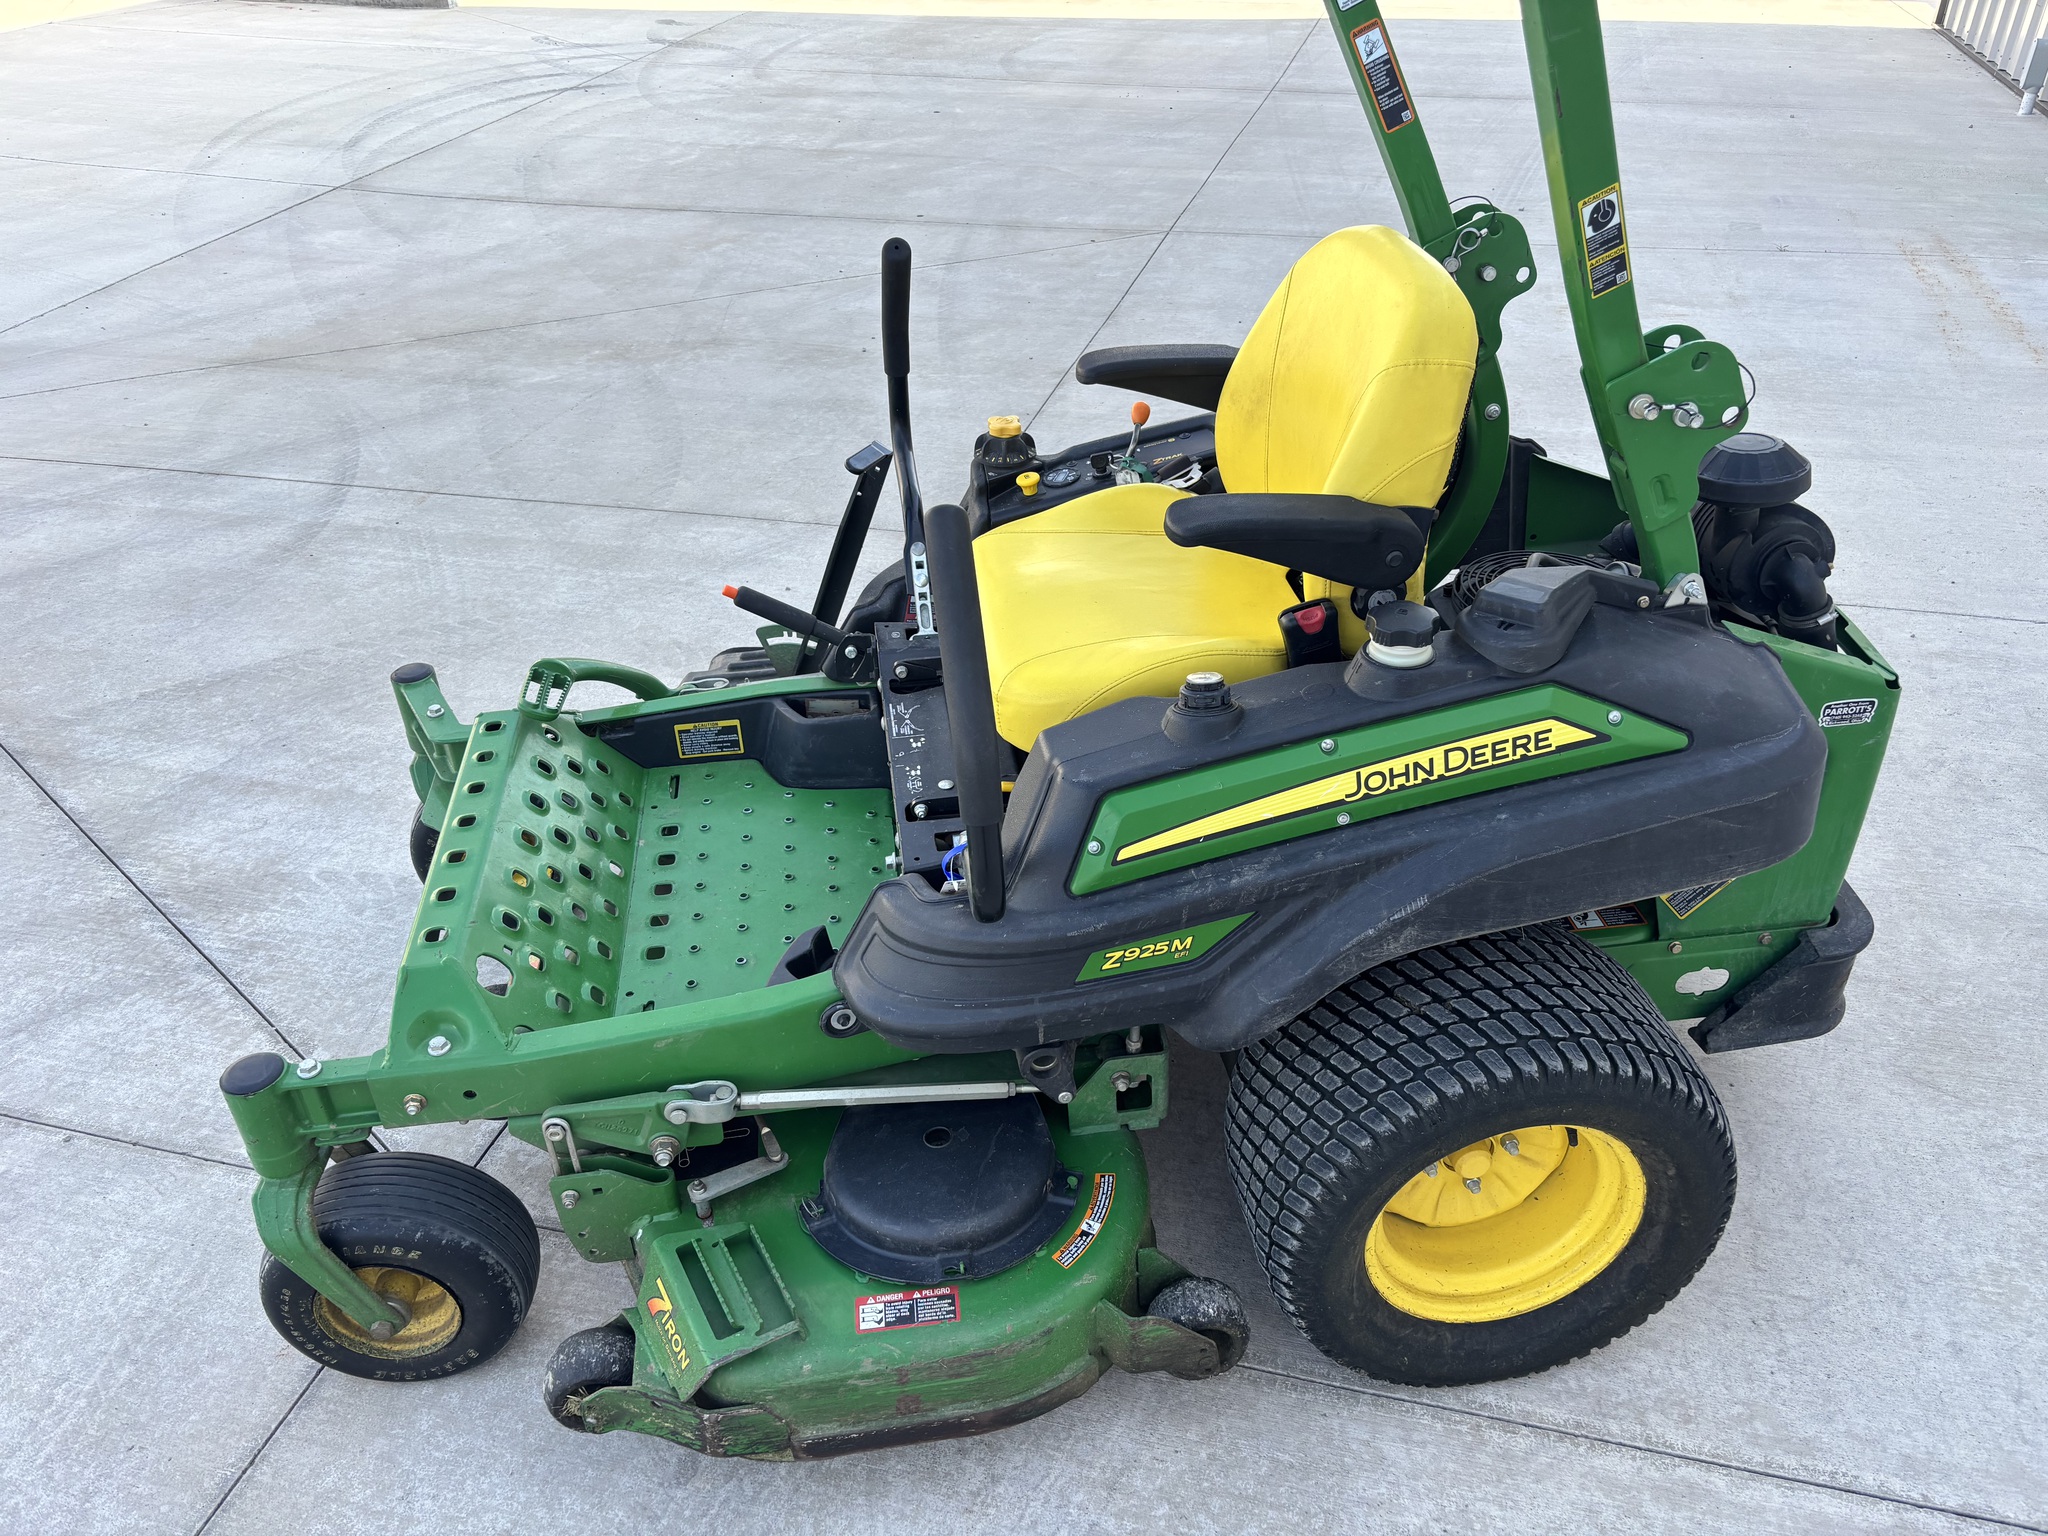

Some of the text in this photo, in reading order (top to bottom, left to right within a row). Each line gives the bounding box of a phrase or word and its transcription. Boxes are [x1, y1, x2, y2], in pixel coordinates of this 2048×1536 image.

[1586, 185, 1616, 205] CAUTION
[1824, 704, 1873, 716] PARROTT'S
[1344, 728, 1553, 799] JOHN DEERE
[1174, 950, 1189, 959] EFI
[876, 1286, 951, 1303] DANGER PELIGRO
